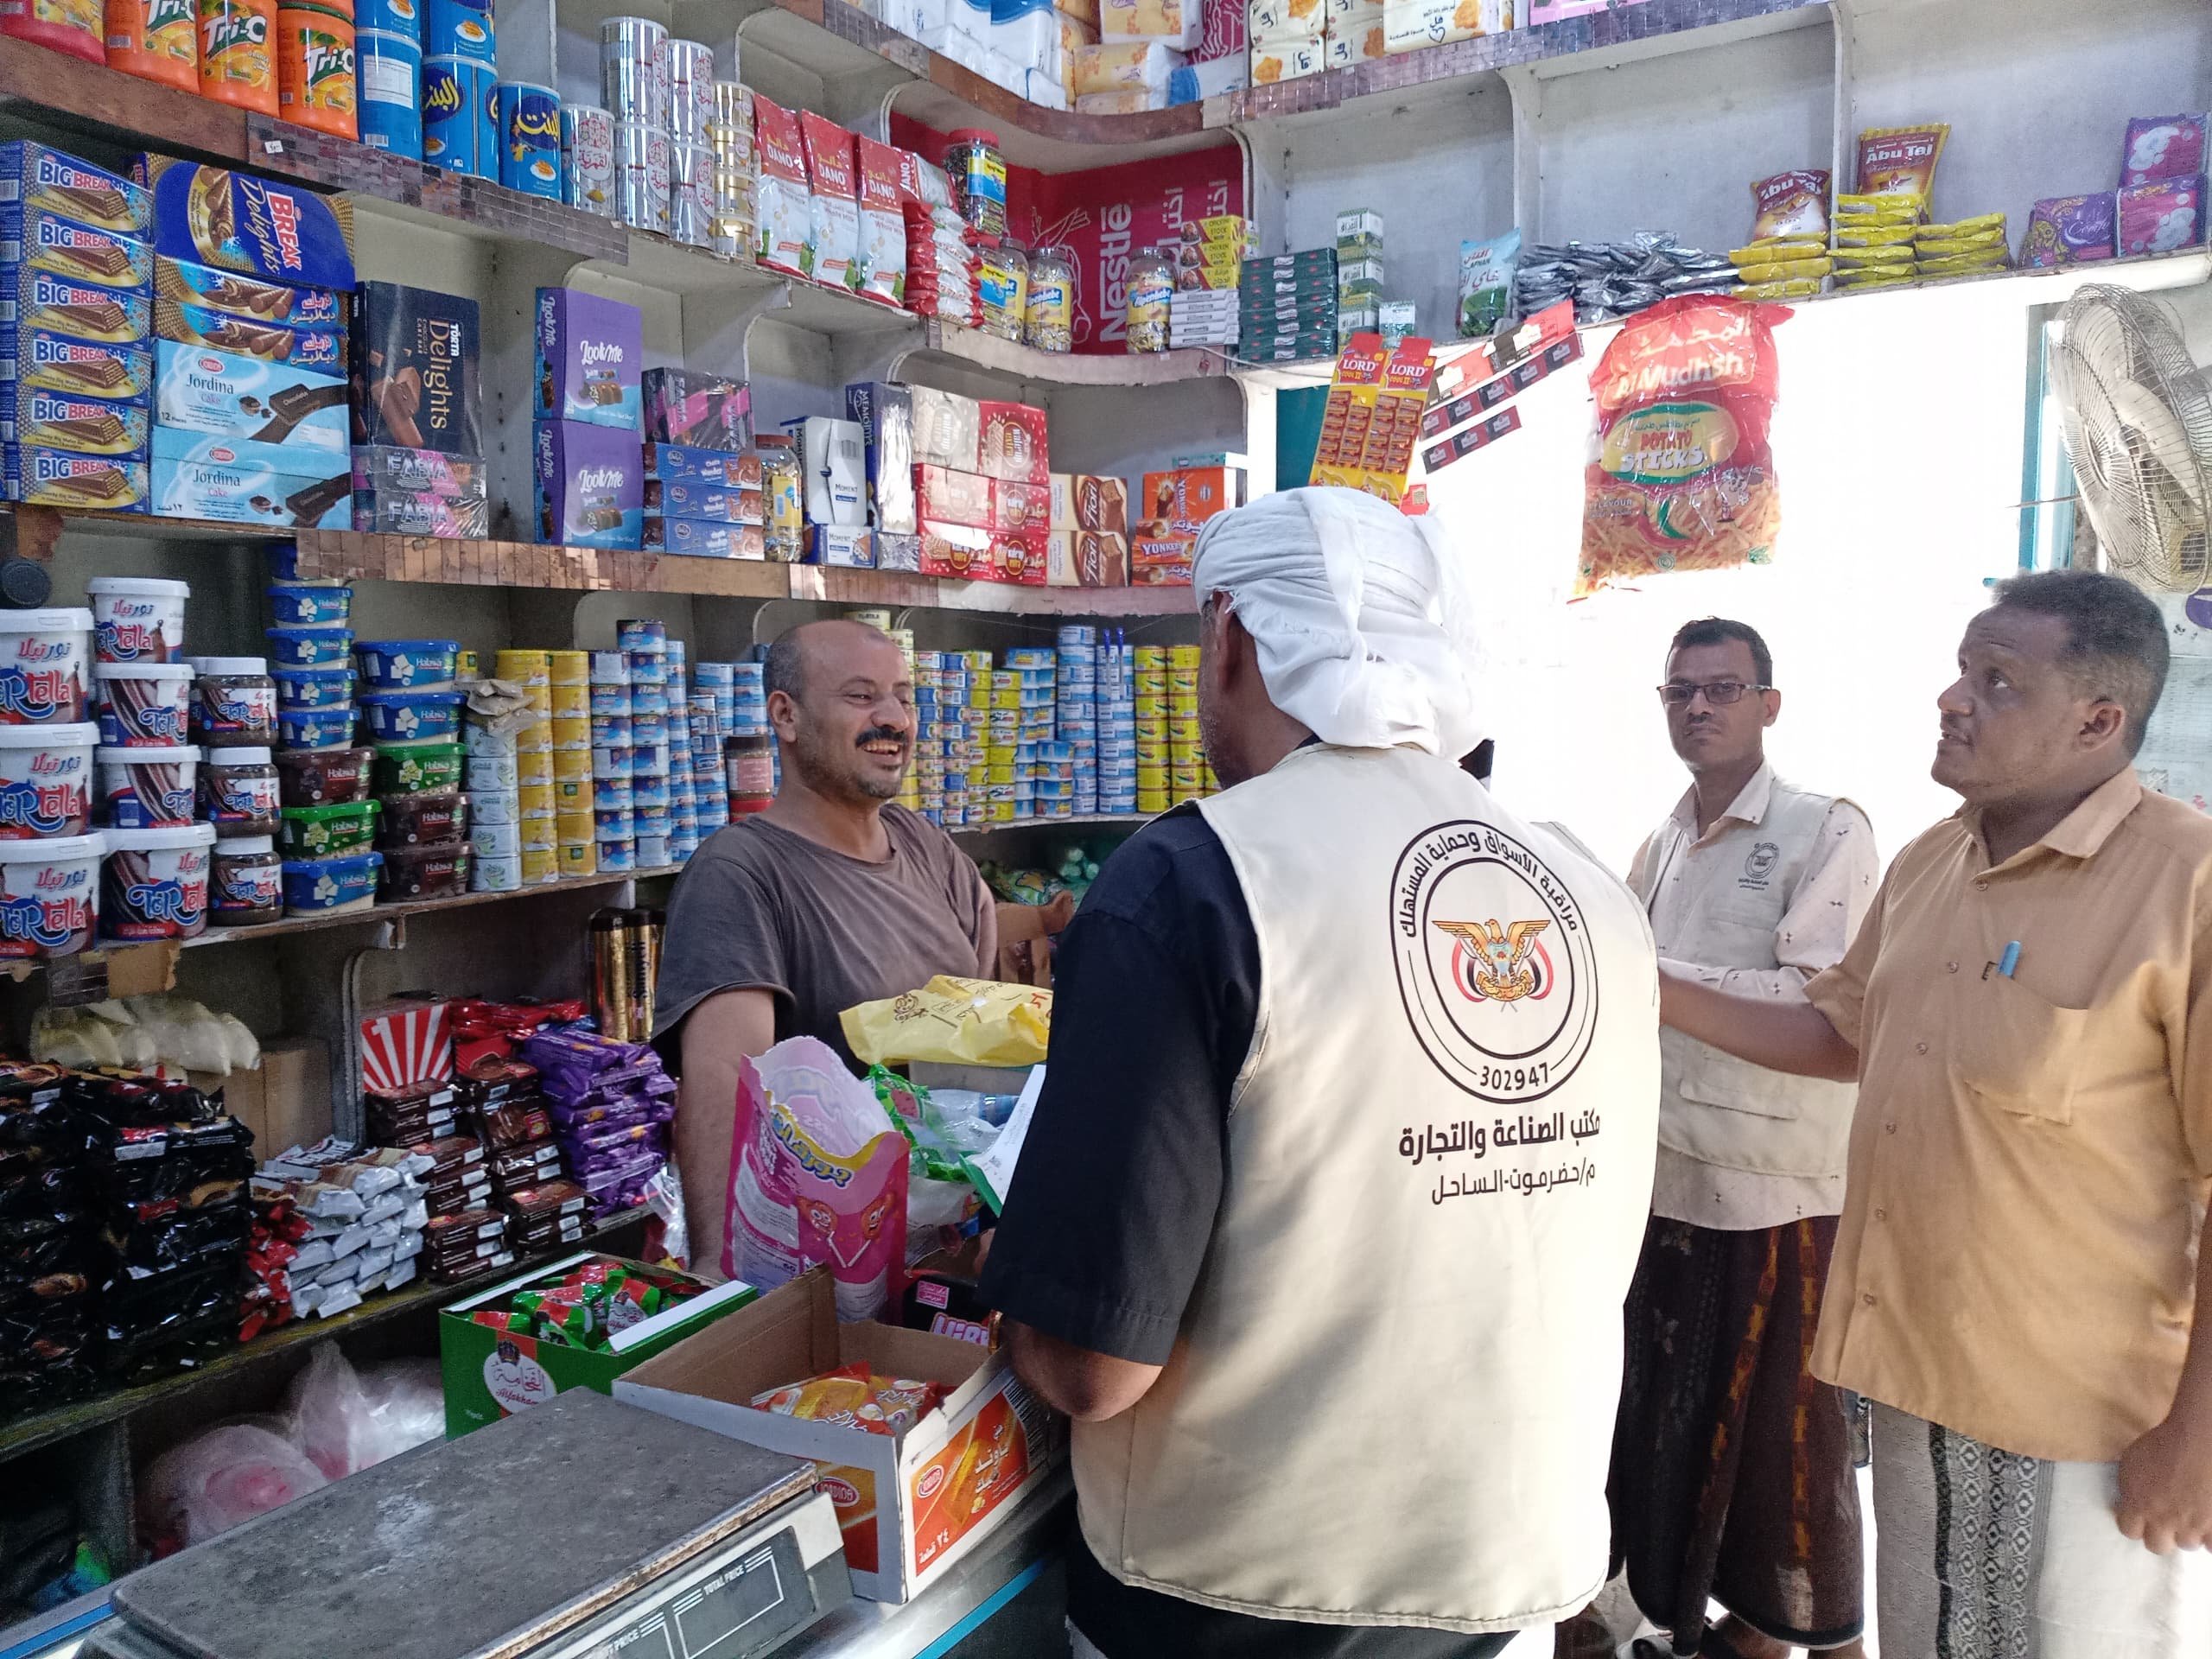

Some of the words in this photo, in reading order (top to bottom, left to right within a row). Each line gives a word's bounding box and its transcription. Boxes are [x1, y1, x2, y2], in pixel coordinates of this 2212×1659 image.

[204, 14, 267, 57] Tri-C
[766, 144, 794, 168] DANO
[1866, 149, 1903, 165] Abu
[38, 158, 73, 188] BIG
[73, 170, 112, 191] BREAK
[818, 162, 846, 185] DANO
[868, 180, 896, 200] DANO
[1207, 180, 1228, 217] اخت
[38, 219, 73, 249] BIG
[73, 231, 112, 250] BREAK
[238, 177, 281, 275] Delights
[266, 191, 303, 271] BREAK
[36, 280, 70, 306] BIG
[69, 288, 111, 306] BREAK
[34, 339, 69, 363] BIG
[69, 345, 109, 361] BREAK
[1343, 359, 1376, 372] LORD
[187, 373, 234, 395] Jordina
[423, 320, 452, 429] Delights
[1390, 365, 1426, 377] LORD
[32, 398, 67, 422] BIG
[67, 403, 106, 420] BREAK
[1640, 429, 1693, 450] POTATO
[35, 457, 70, 481] BIG
[69, 459, 109, 477] BREAK
[1620, 446, 1706, 473] STICKS
[193, 469, 241, 486] Jordina
[1426, 831, 1481, 861] وحماية
[1484, 830, 1538, 878] الأسواق
[1400, 852, 1433, 938] المستهلك
[1540, 874, 1578, 931] مراقبة
[1479, 1062, 1550, 1091] 302947
[1493, 1111, 1565, 1147] الصناعة
[1570, 1108, 1600, 1147] مكتب
[1399, 1120, 1486, 1166] والتجارة
[704, 1577, 726, 1596] TOTAL
[724, 1564, 745, 1583] PRICE
[614, 1629, 639, 1651] PRICE
